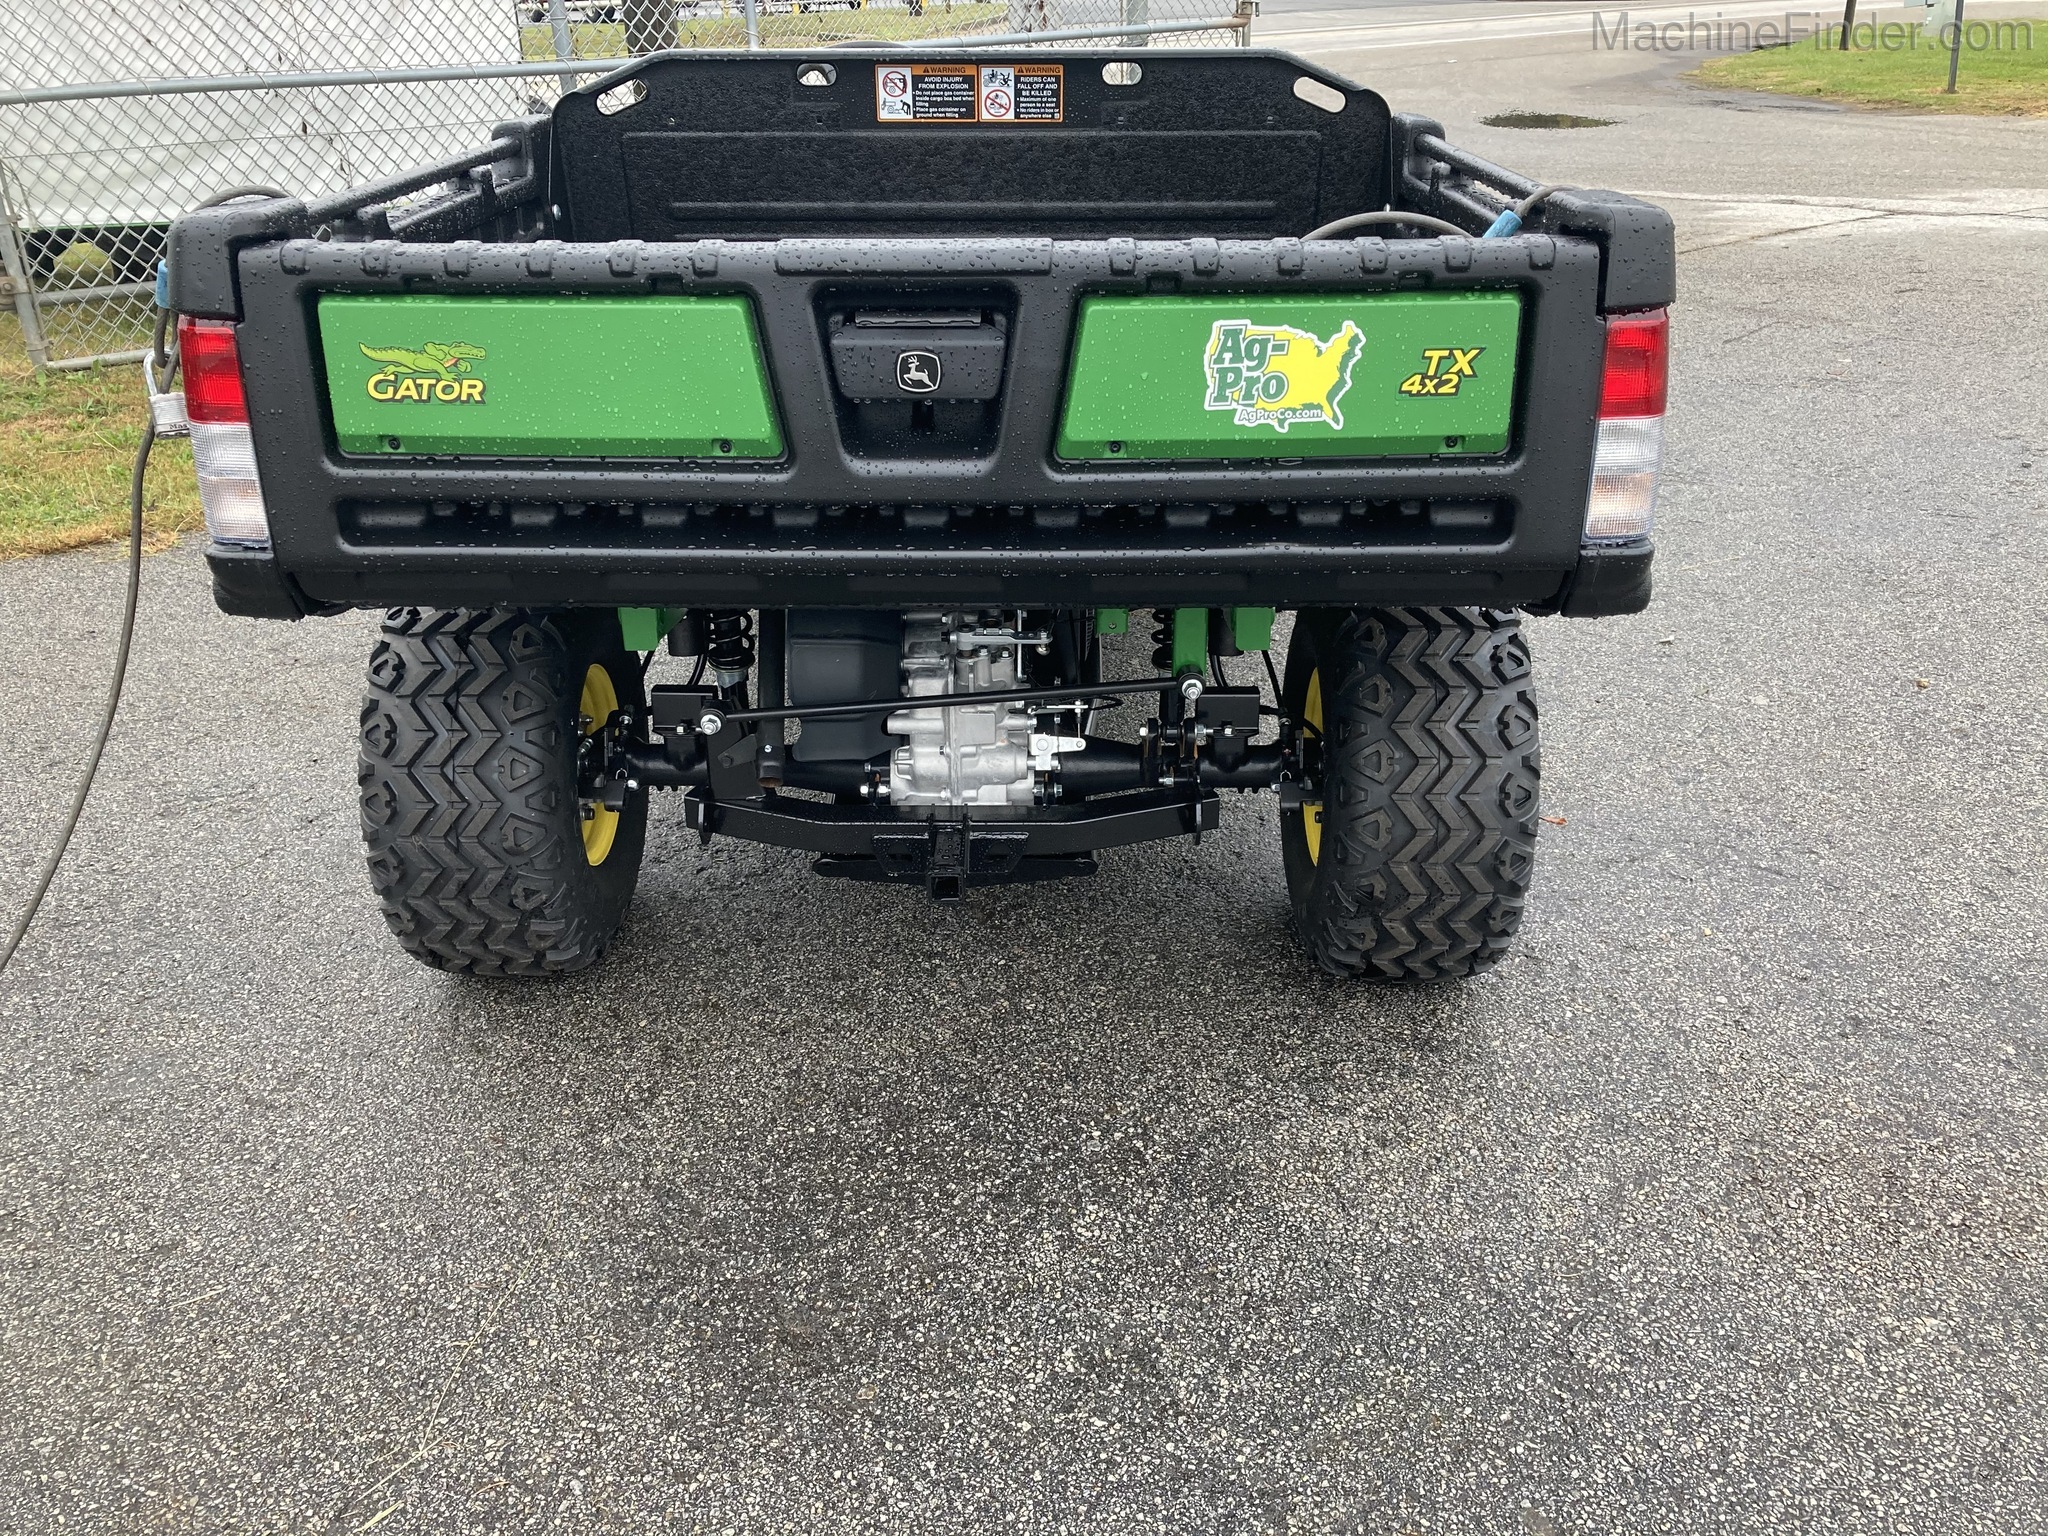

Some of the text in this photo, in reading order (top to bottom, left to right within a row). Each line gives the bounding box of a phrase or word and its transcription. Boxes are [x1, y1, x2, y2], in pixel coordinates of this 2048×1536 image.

[1210, 324, 1290, 372] Ag-
[1422, 348, 1485, 378] TX
[1209, 366, 1289, 406] Pro
[1399, 374, 1462, 396] 4x2
[1239, 408, 1322, 422] AgProCo.com
